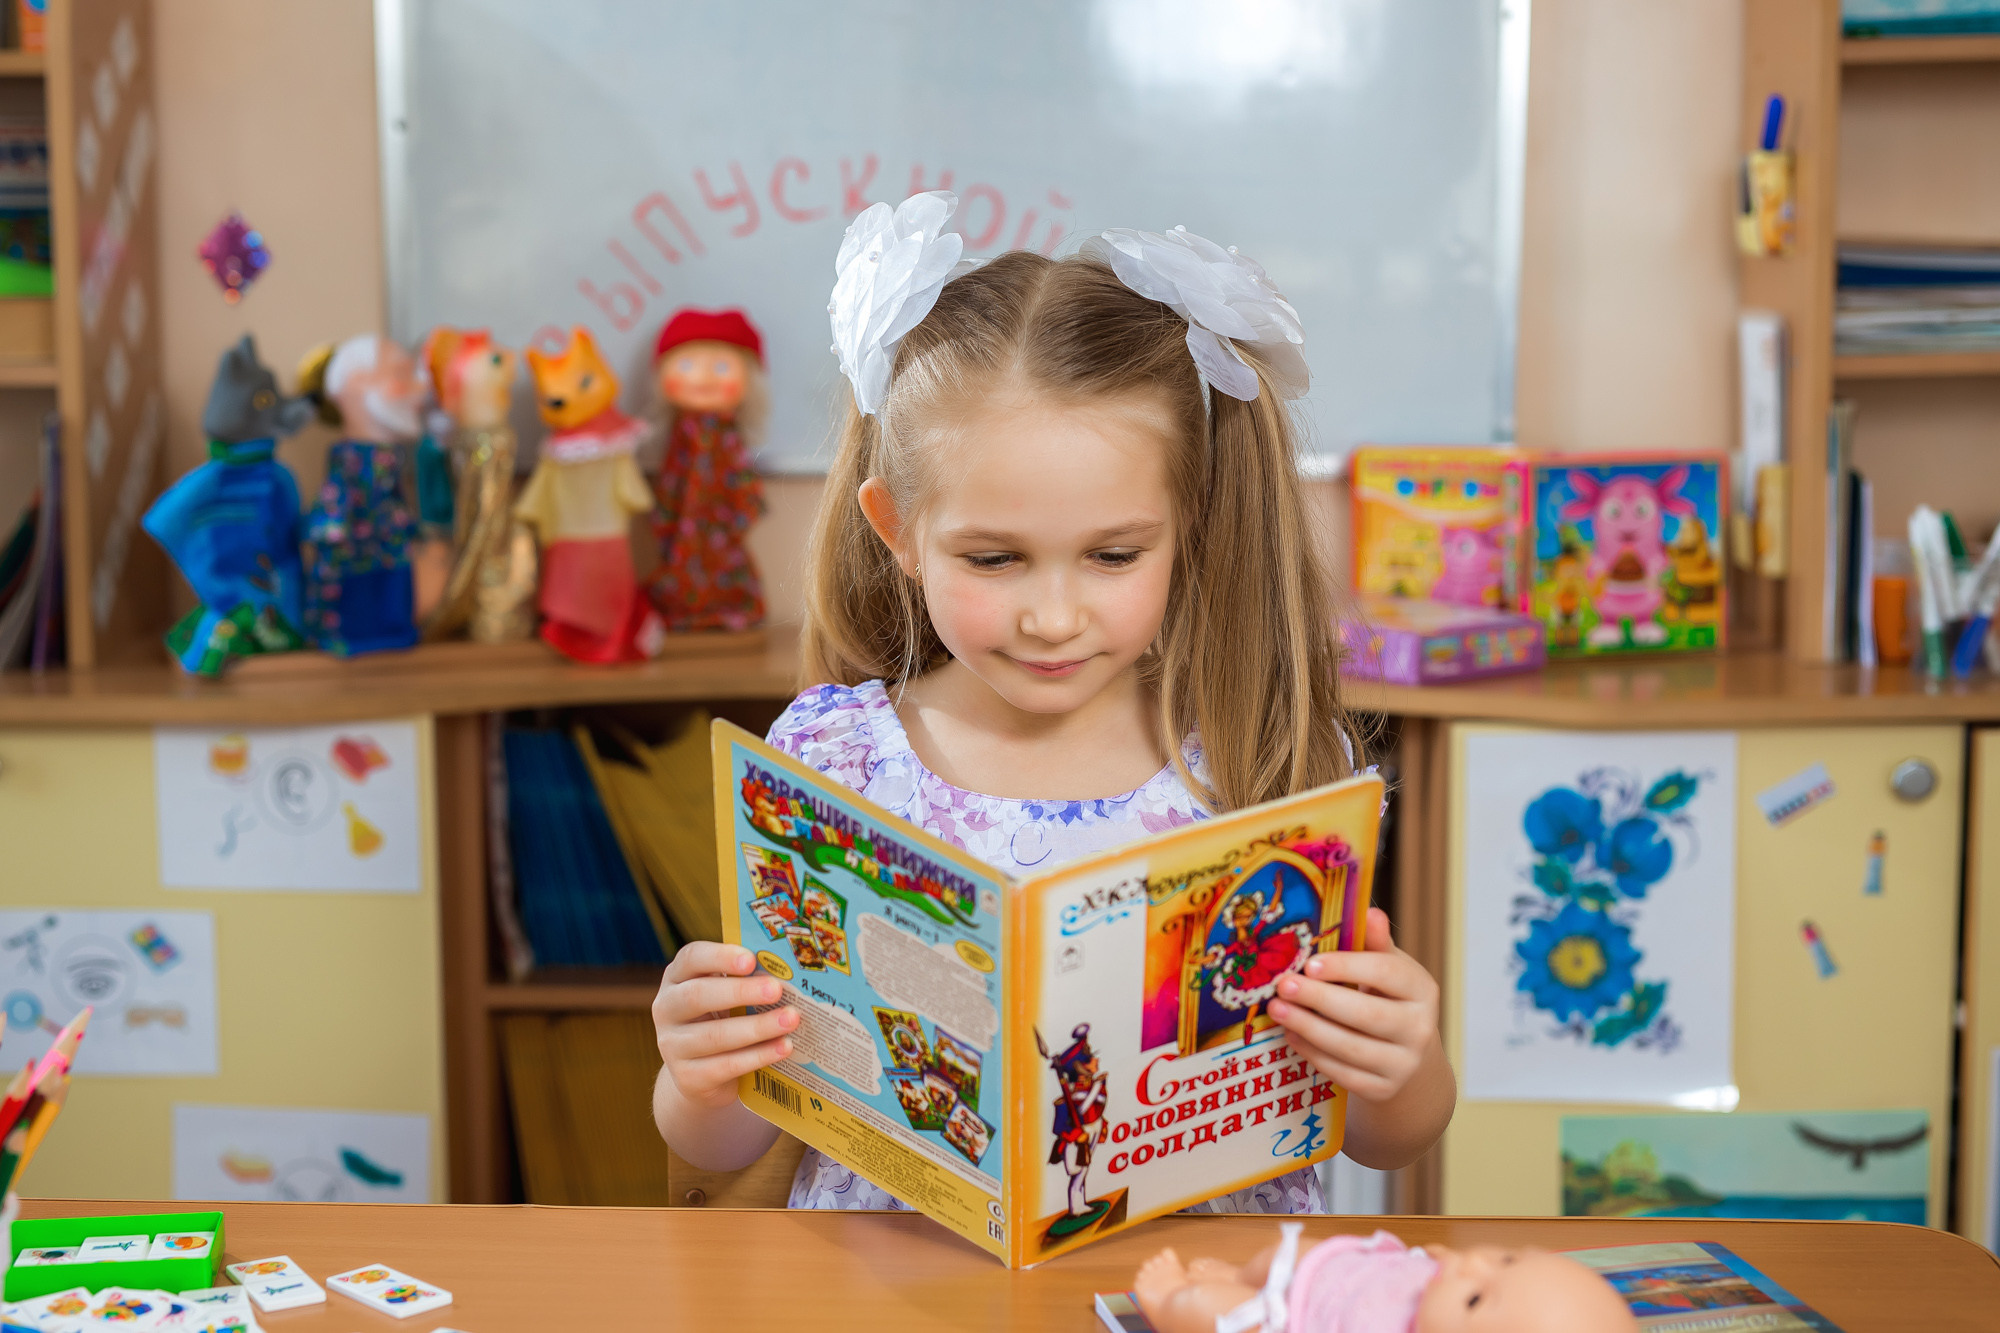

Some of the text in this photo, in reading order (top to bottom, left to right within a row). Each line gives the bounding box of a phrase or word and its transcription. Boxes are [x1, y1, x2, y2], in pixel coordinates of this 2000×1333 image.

[802, 978, 809, 991] Я
[1135, 1044, 1297, 1106] Стойки
[809, 1096, 823, 1112] 19
[1111, 1060, 1320, 1143] оловянны
